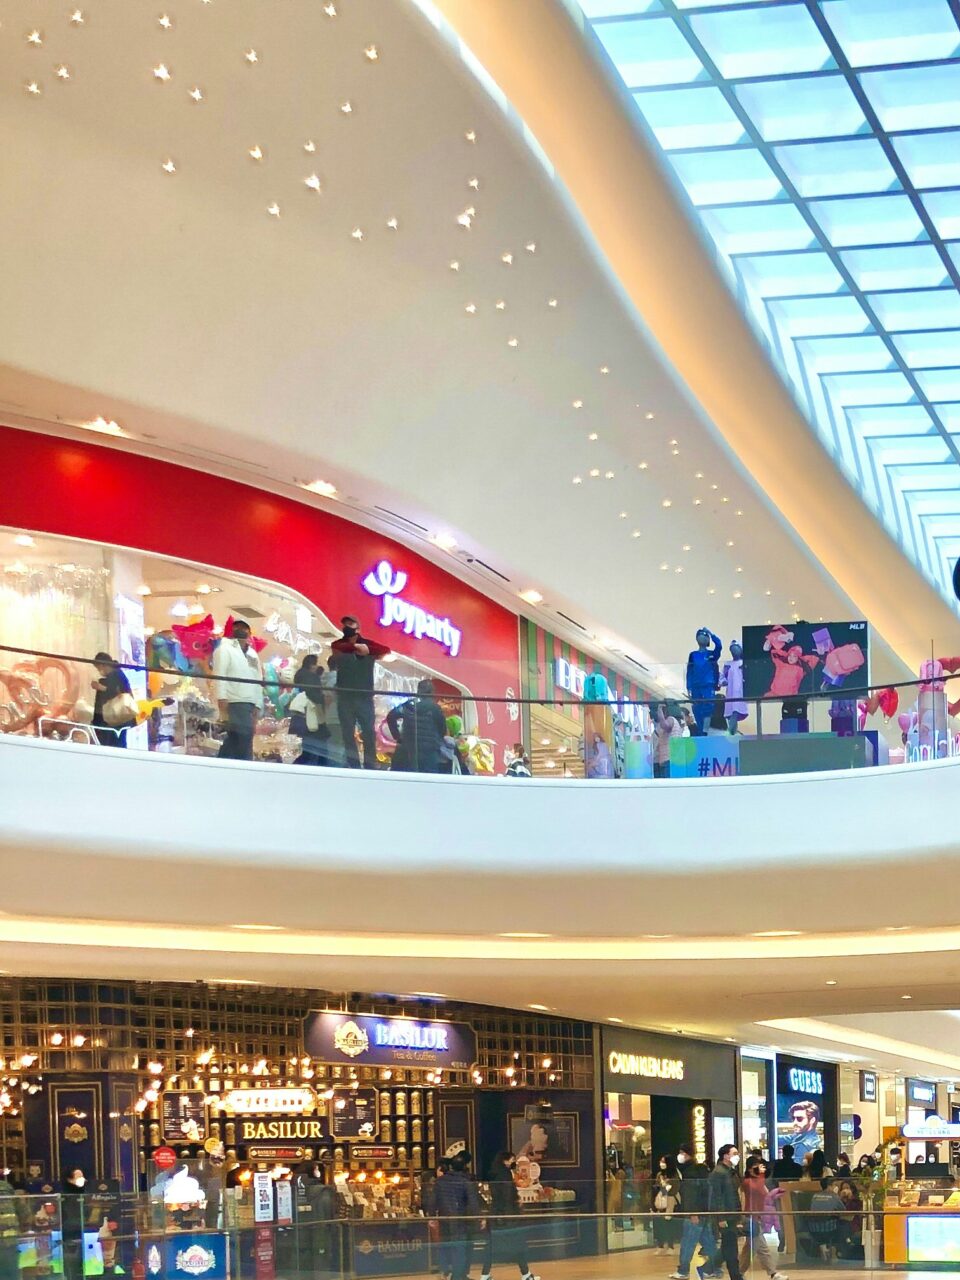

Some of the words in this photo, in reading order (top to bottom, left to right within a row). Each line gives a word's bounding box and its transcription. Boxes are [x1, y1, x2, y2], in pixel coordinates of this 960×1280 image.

[379, 593, 462, 657] joyparty
[375, 1023, 449, 1050] BASILUR
[414, 1050, 437, 1062] Coffee
[609, 1051, 639, 1075] CALVIN
[639, 1055, 660, 1077] KLEIN
[660, 1058, 684, 1080] JEANS
[789, 1067, 823, 1095] GUESS
[242, 1121, 324, 1140] BASILUR
[377, 1239, 422, 1253] BASILUR
